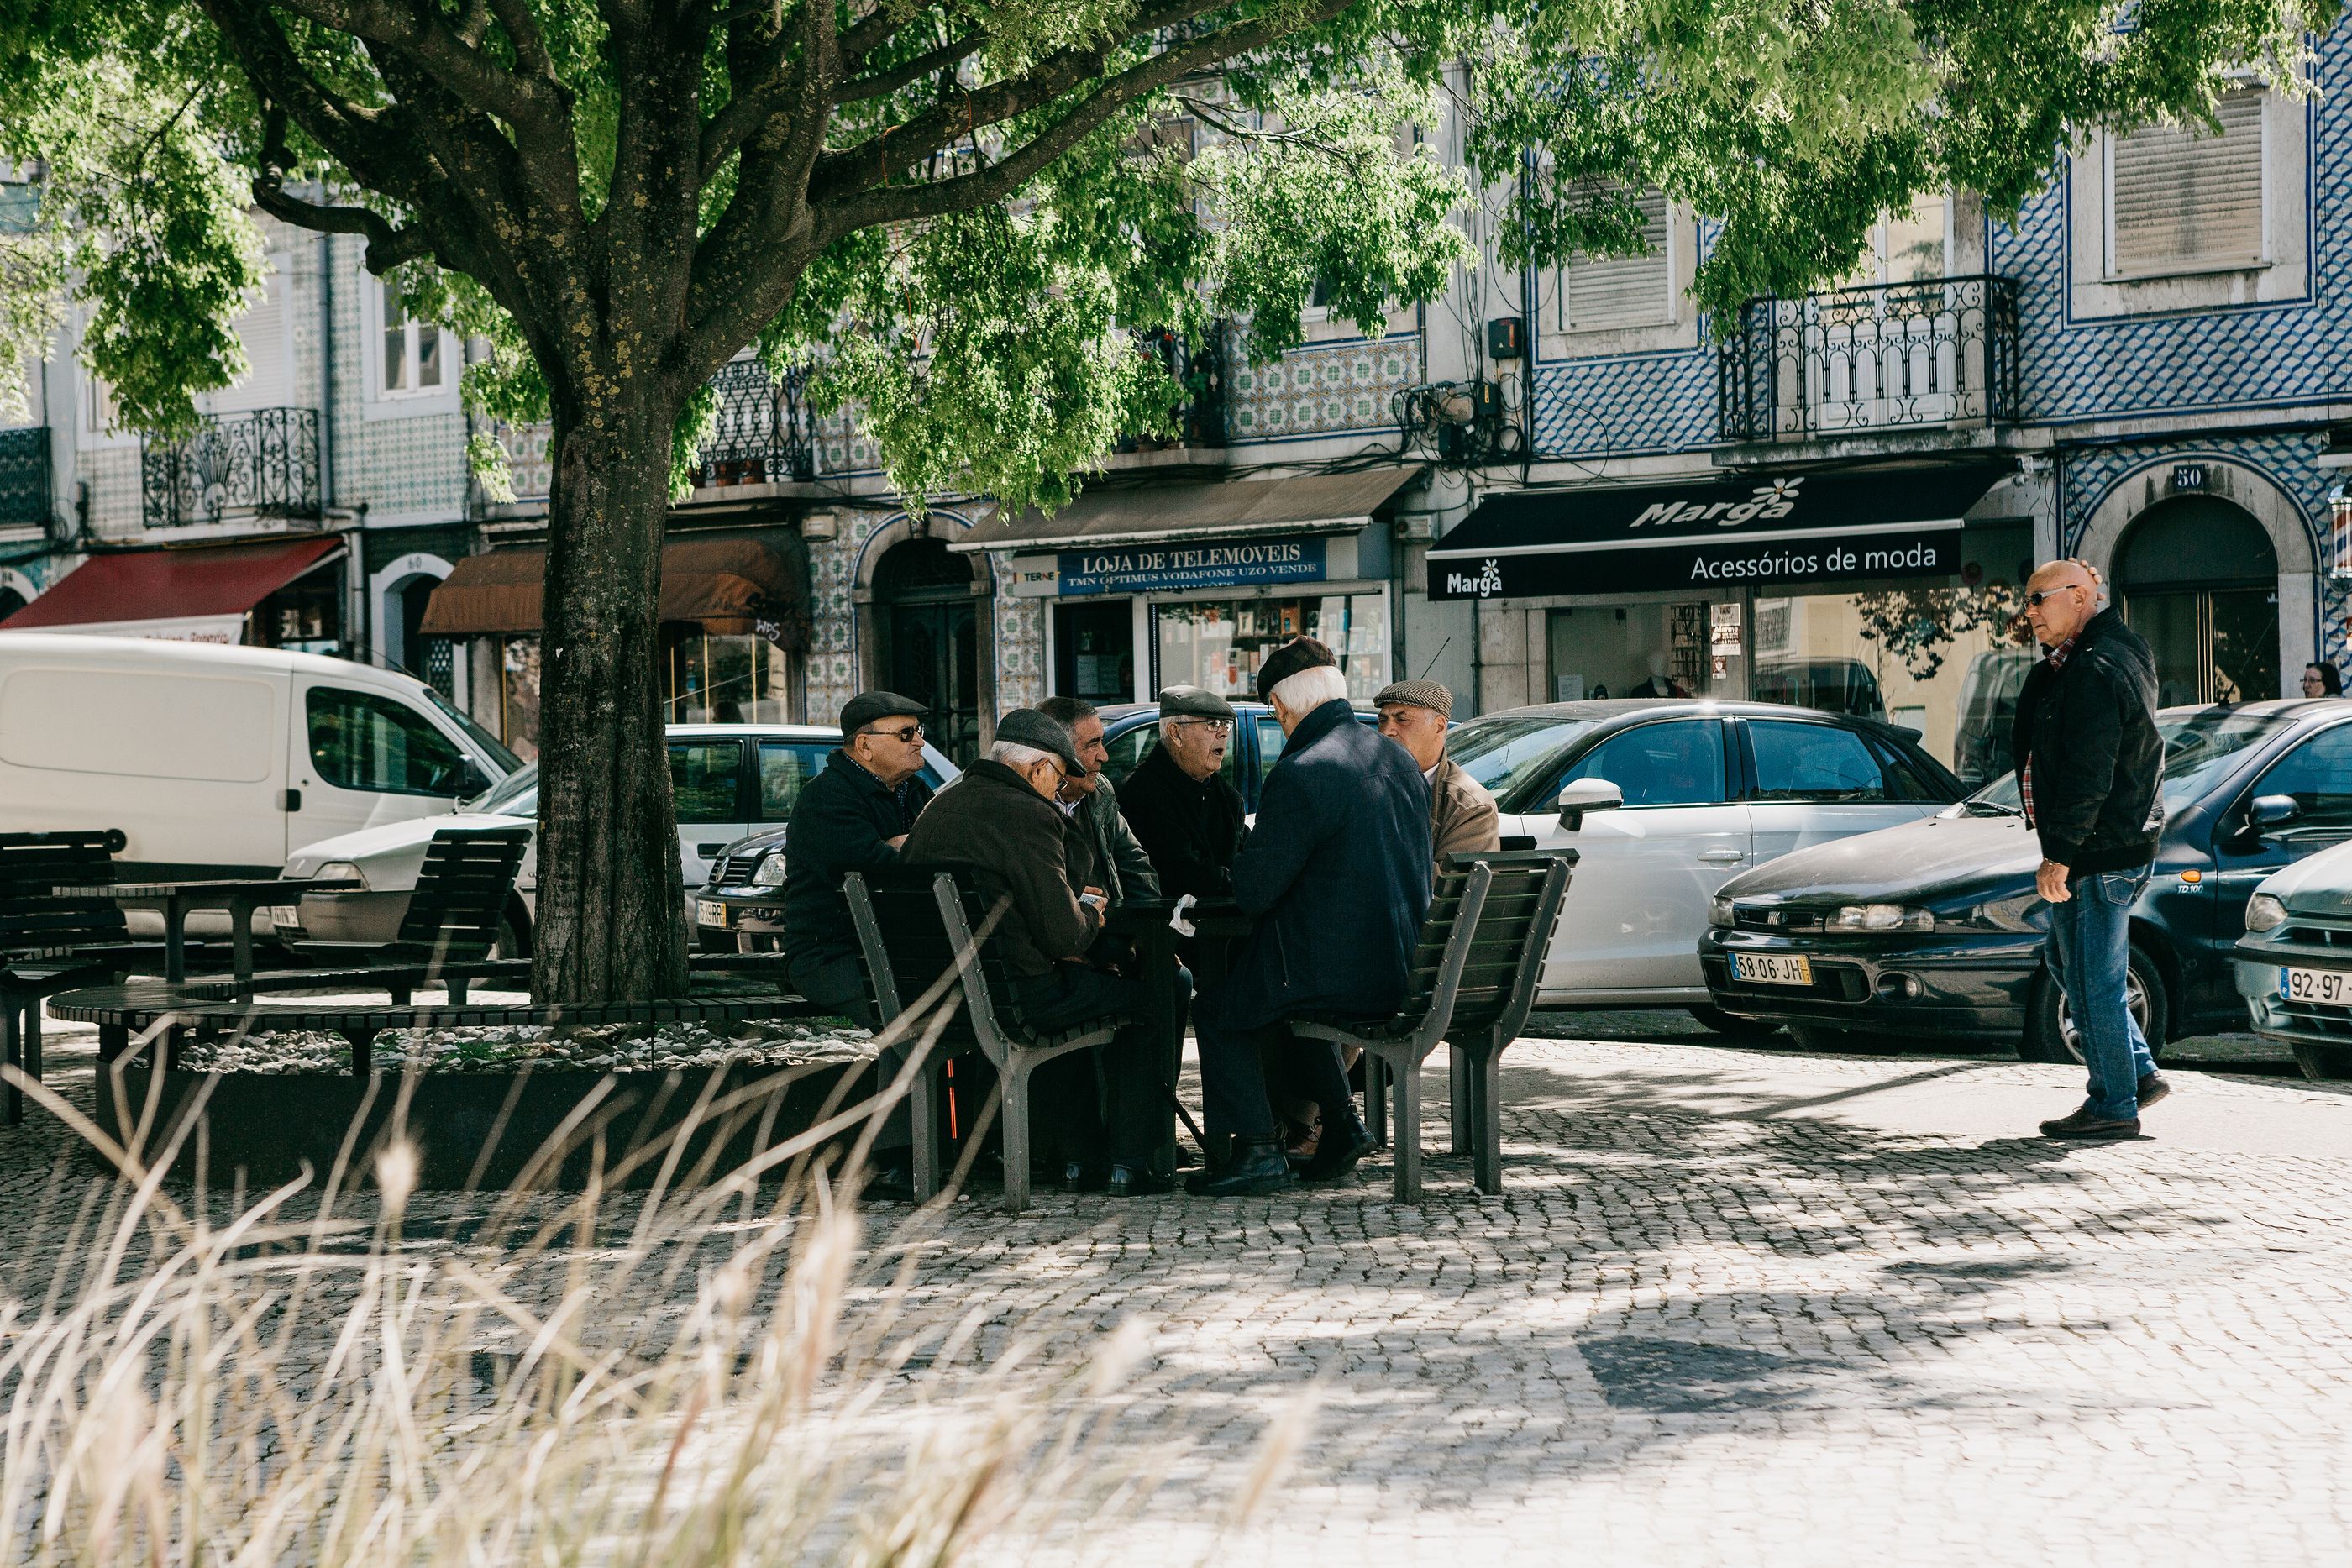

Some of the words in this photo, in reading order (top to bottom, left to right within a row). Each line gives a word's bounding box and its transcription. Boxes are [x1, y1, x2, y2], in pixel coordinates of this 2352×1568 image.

[2177, 469, 2202, 487] 50
[1629, 501, 1795, 527] Marga
[1082, 555, 1134, 574] LOJA
[1137, 553, 1166, 571] DE
[1170, 543, 1301, 569] TELEMÓVEIS
[1691, 550, 1818, 579] Acessórios
[1826, 547, 1856, 572] de
[1865, 542, 1936, 570] moda
[1068, 577, 1096, 587] TMN
[1100, 573, 1159, 585] OPTIMUS
[1162, 568, 1236, 581] VODAFONE
[1239, 565, 1266, 577] UZO
[1270, 563, 1317, 574] VENDE
[1447, 573, 1503, 597] Marga
